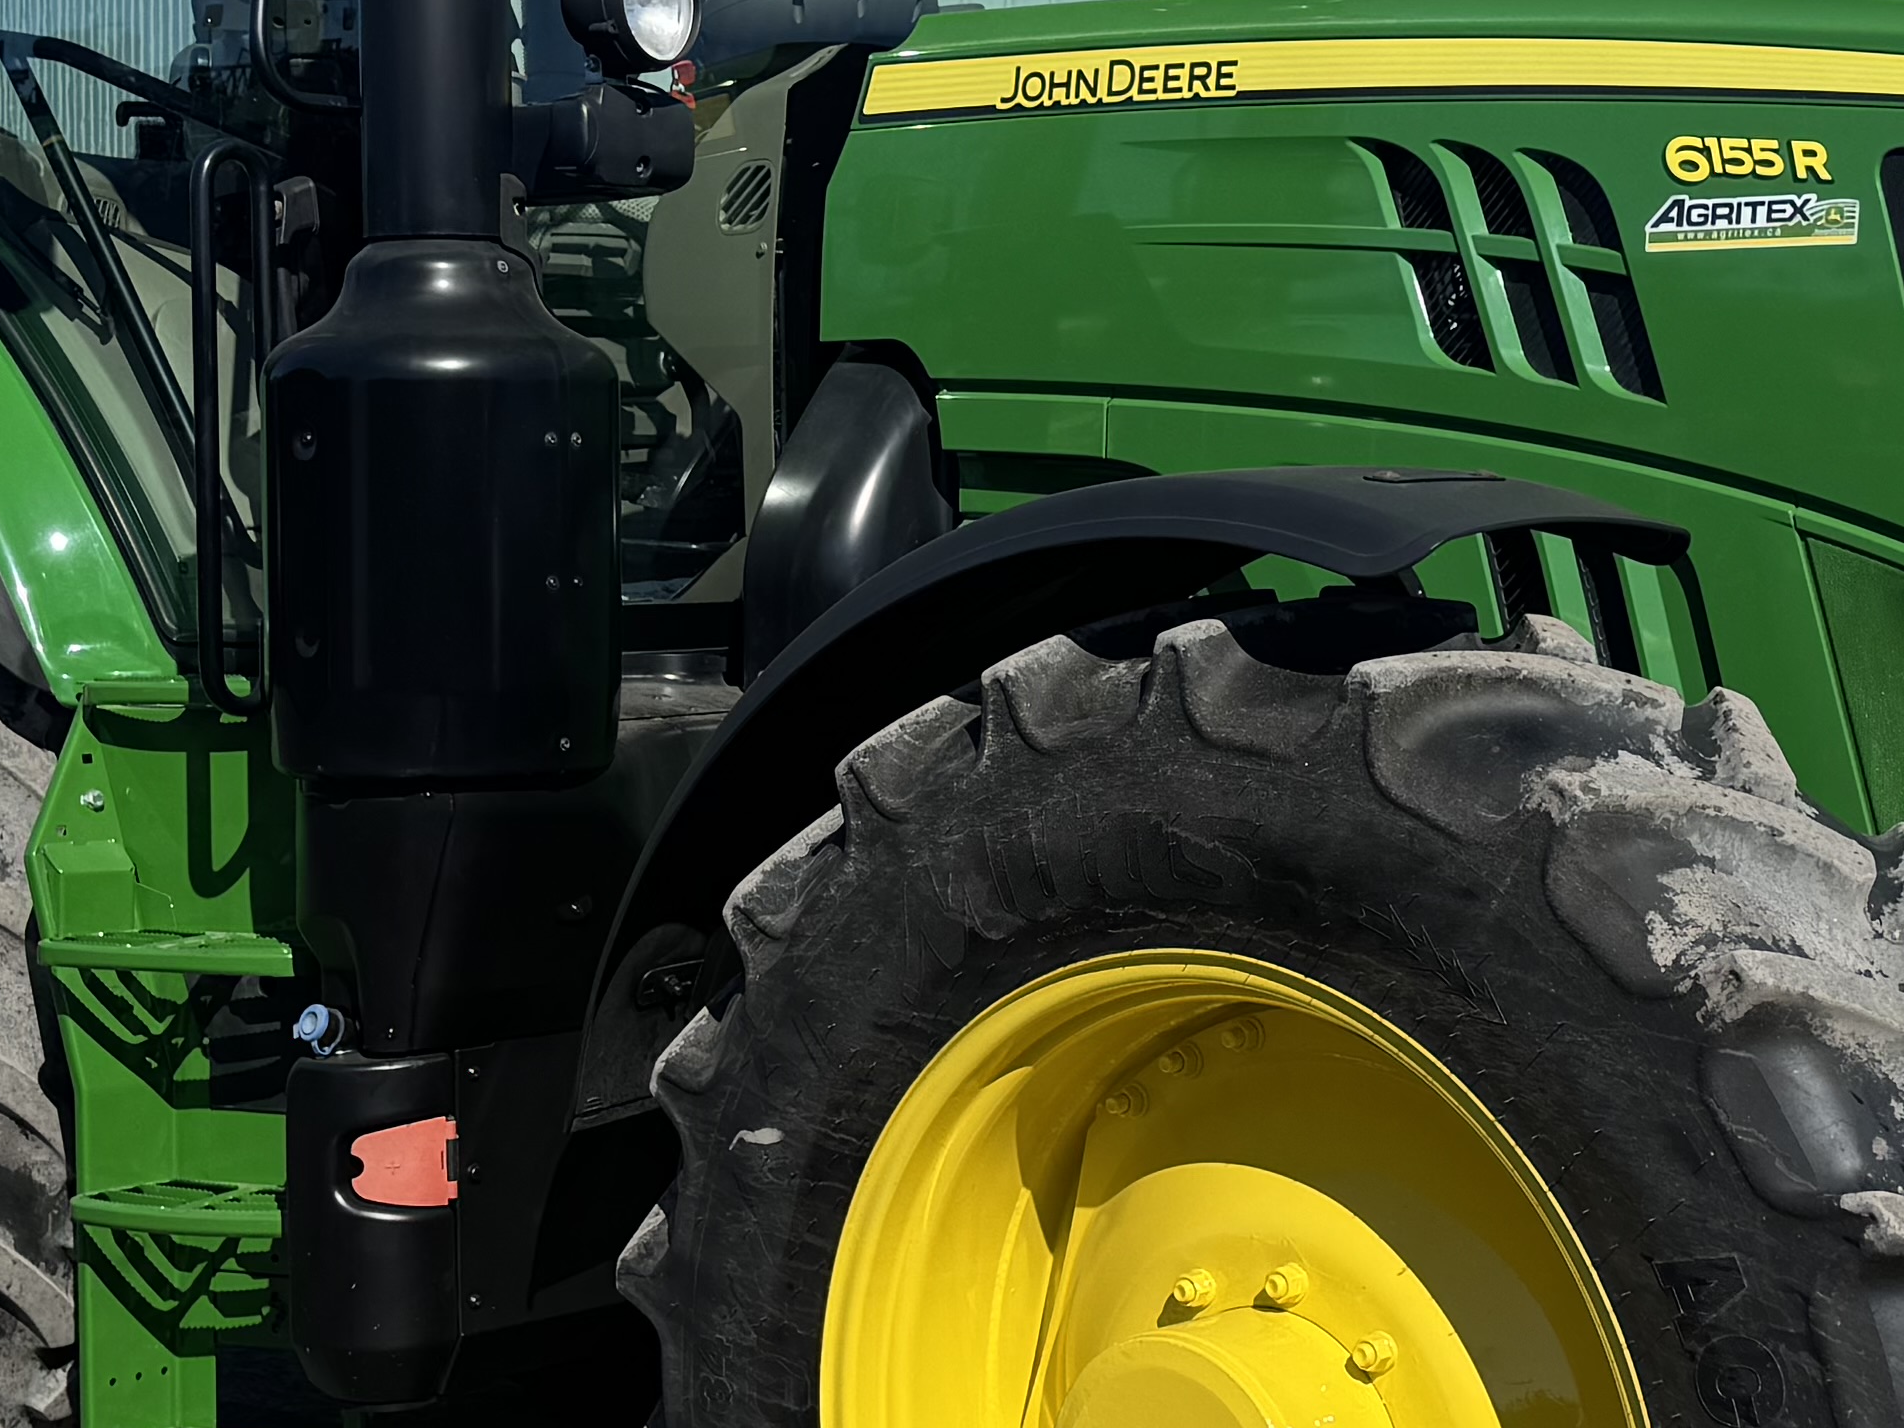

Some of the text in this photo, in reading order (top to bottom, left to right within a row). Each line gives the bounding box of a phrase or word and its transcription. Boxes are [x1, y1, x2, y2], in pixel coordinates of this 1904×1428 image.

[999, 58, 1239, 104] JOHN DEERE
[1664, 135, 1834, 183] 6155 R
[1650, 197, 1813, 229] AGRITEX
